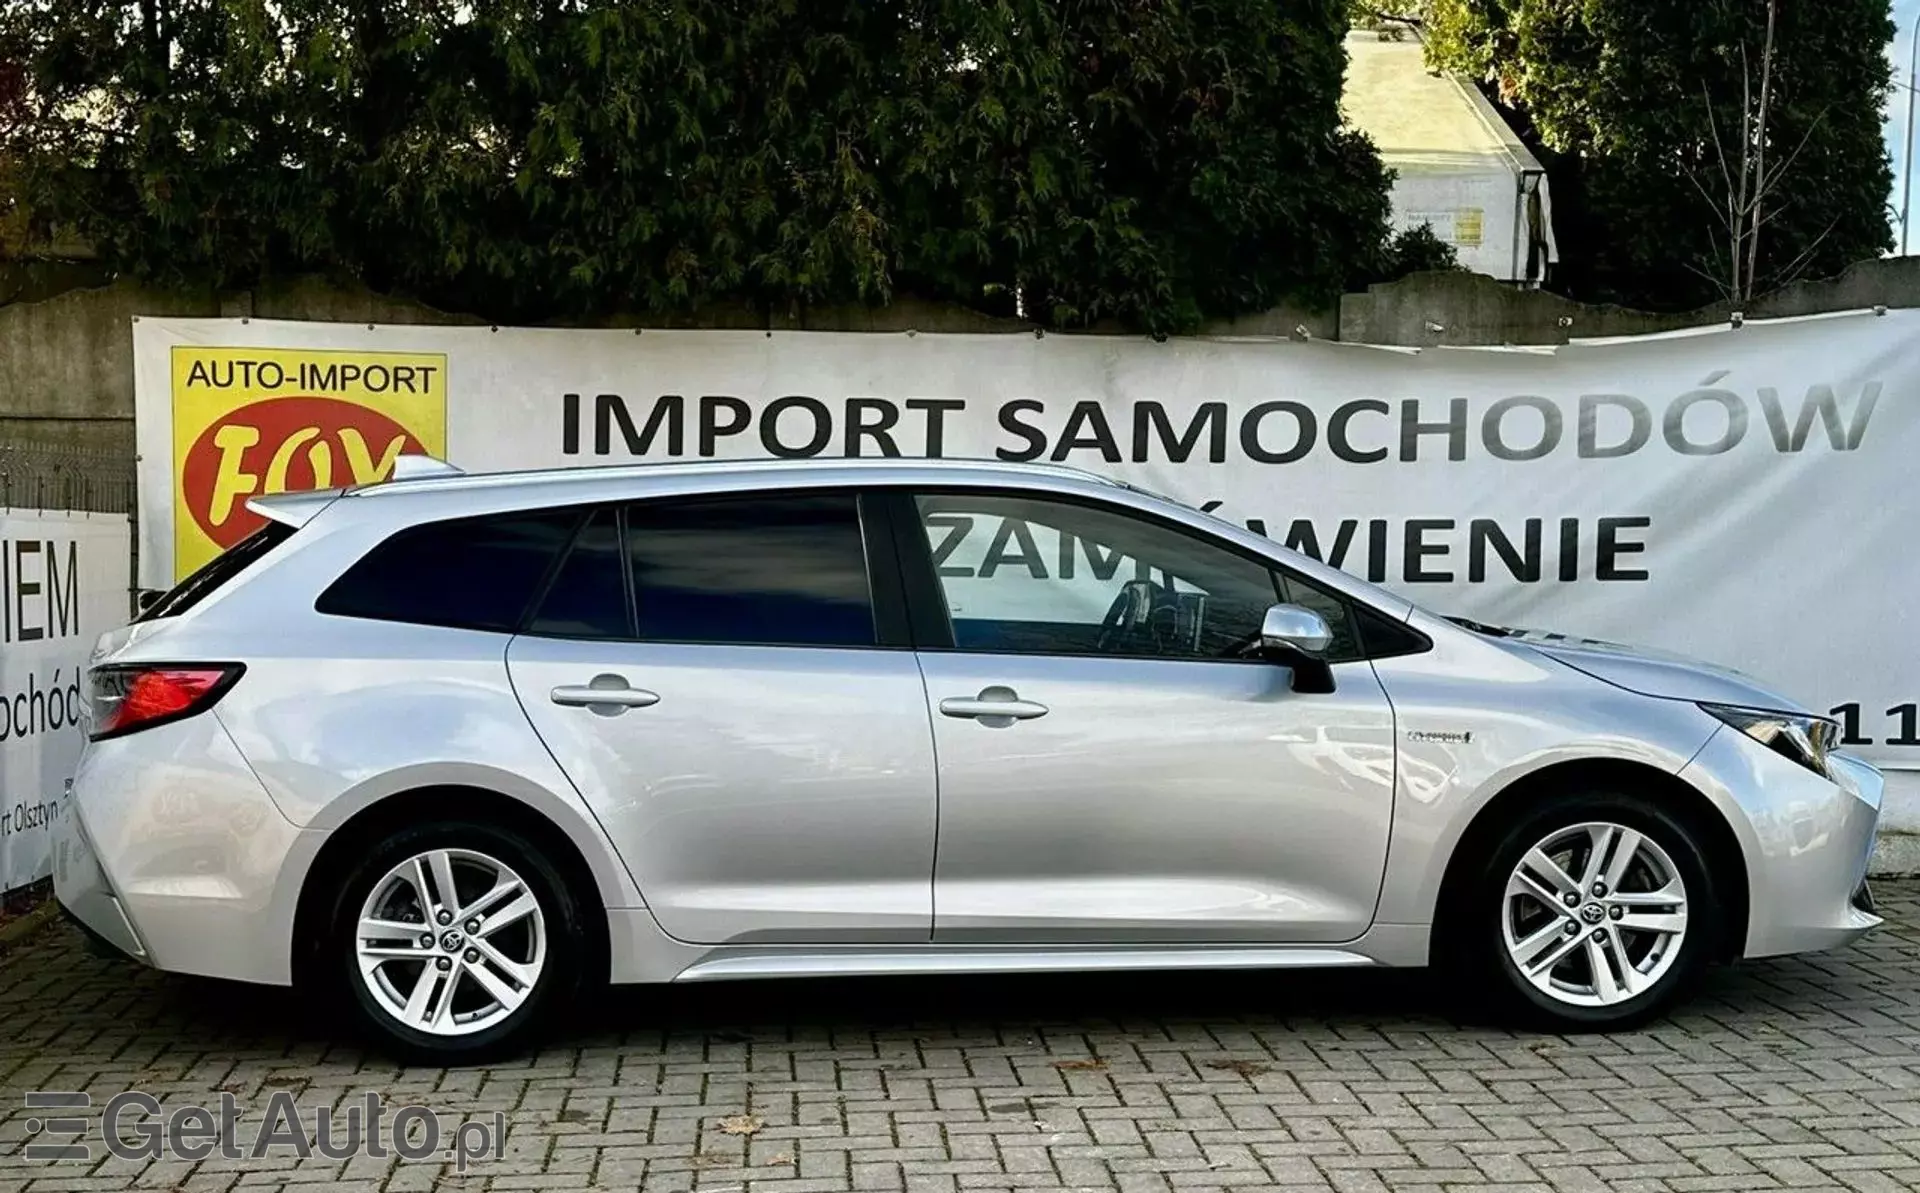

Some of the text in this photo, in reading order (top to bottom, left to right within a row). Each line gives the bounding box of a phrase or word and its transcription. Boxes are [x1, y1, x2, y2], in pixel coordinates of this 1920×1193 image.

[187, 360, 437, 394] AUTO-IMPORT
[562, 370, 1883, 463] IMPORT SAMOCHODÓW
[15, 800, 59, 833] Olsztyn
